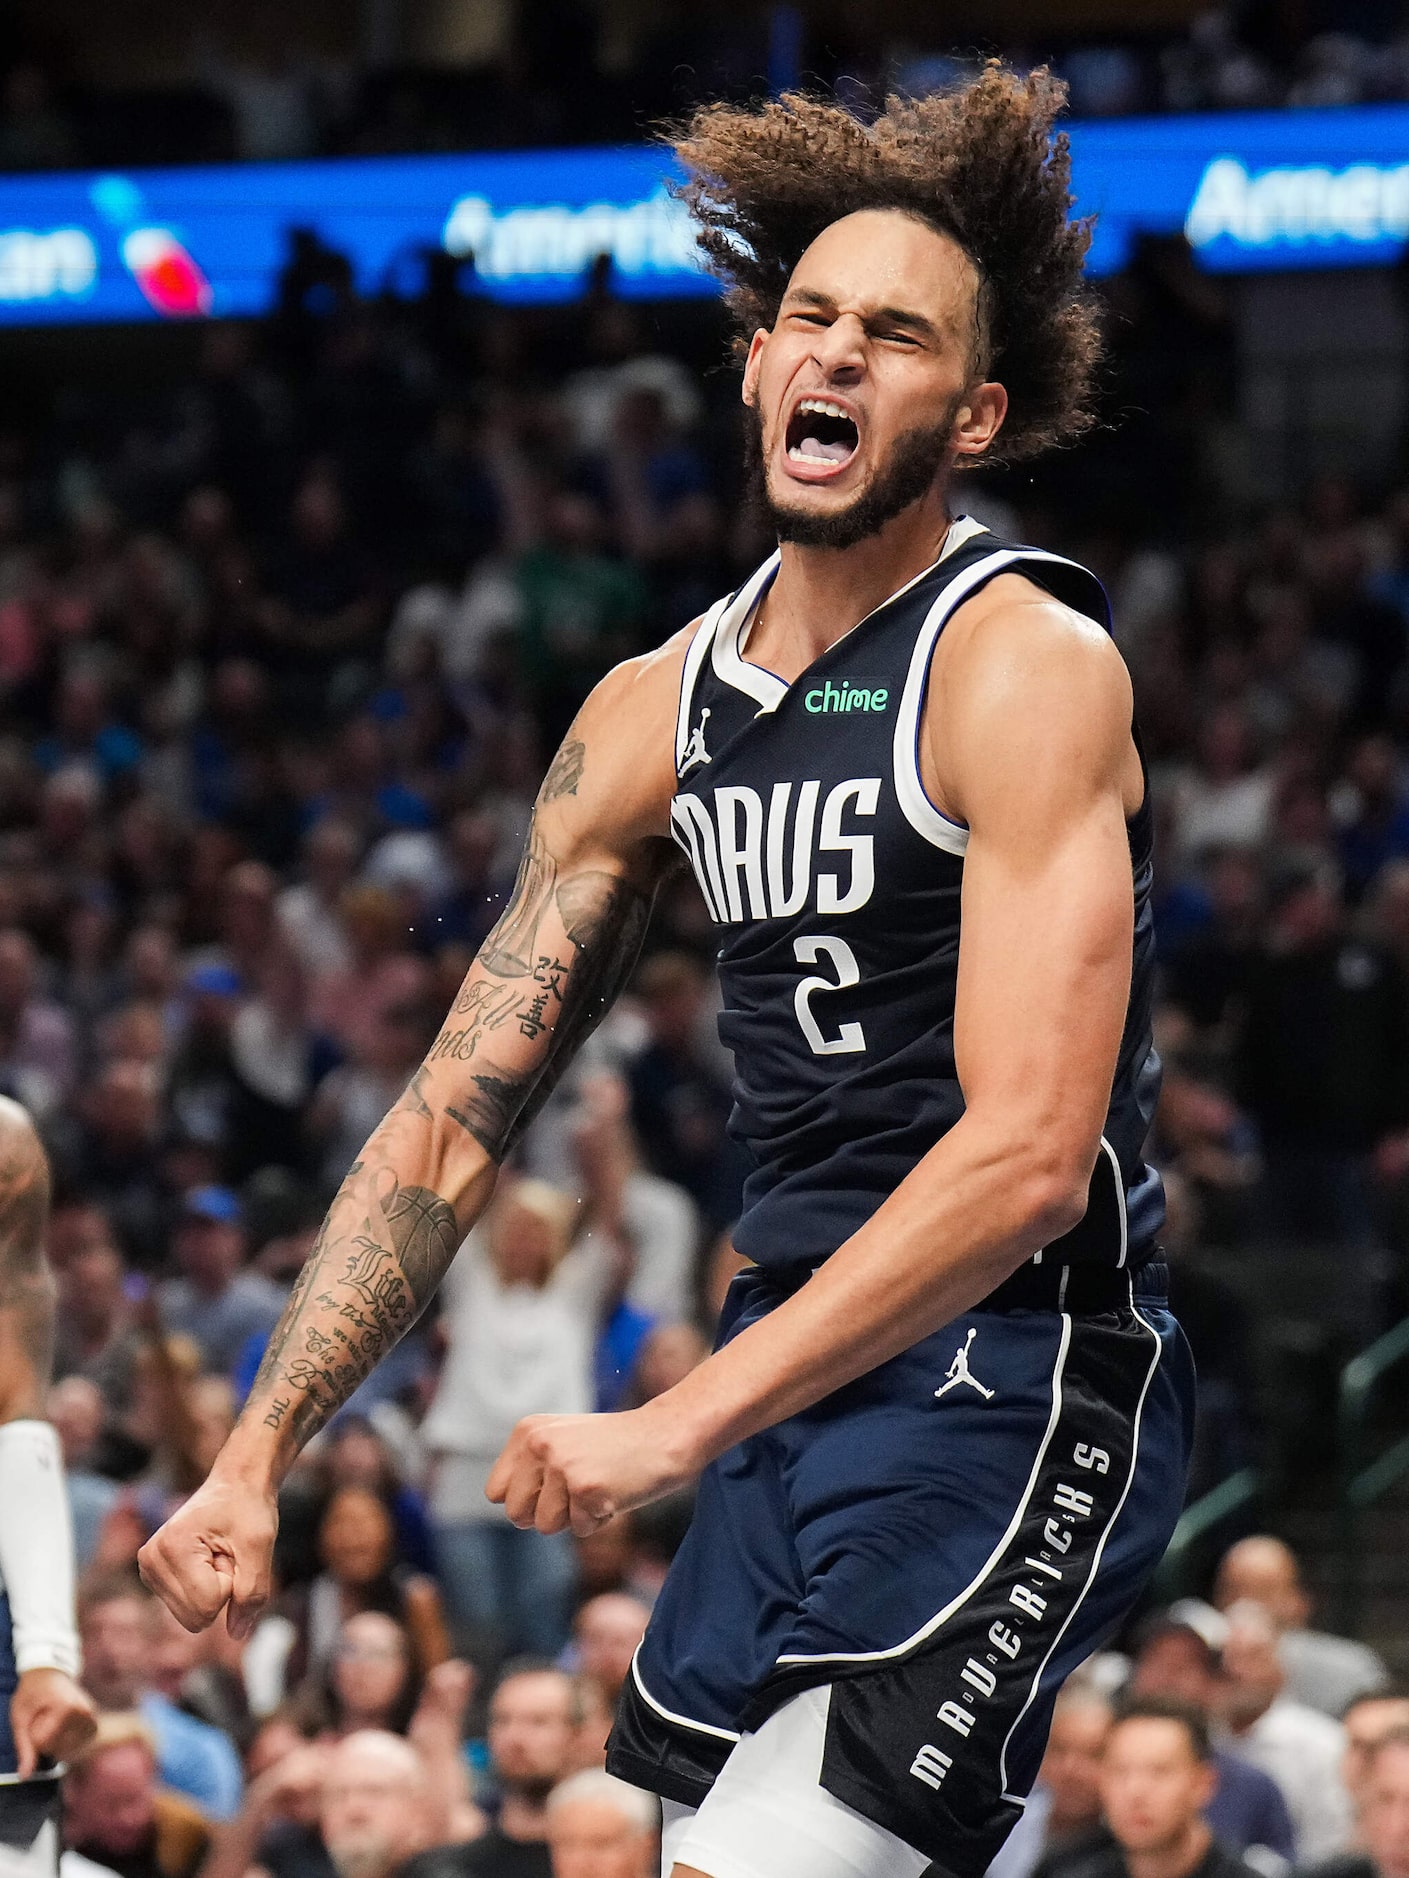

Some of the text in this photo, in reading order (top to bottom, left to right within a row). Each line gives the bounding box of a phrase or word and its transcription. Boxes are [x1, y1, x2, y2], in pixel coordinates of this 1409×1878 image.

[1185, 154, 1409, 248] Amer
[804, 681, 888, 714] chime
[670, 777, 882, 923] MAVS
[516, 956, 569, 1040] 改善
[793, 935, 866, 1055] 2
[337, 1236, 406, 1318] Life
[263, 1397, 290, 1430] D4L
[910, 1442, 1110, 1791] MAVERICKS
[962, 1513, 1075, 1704] DALLAS
